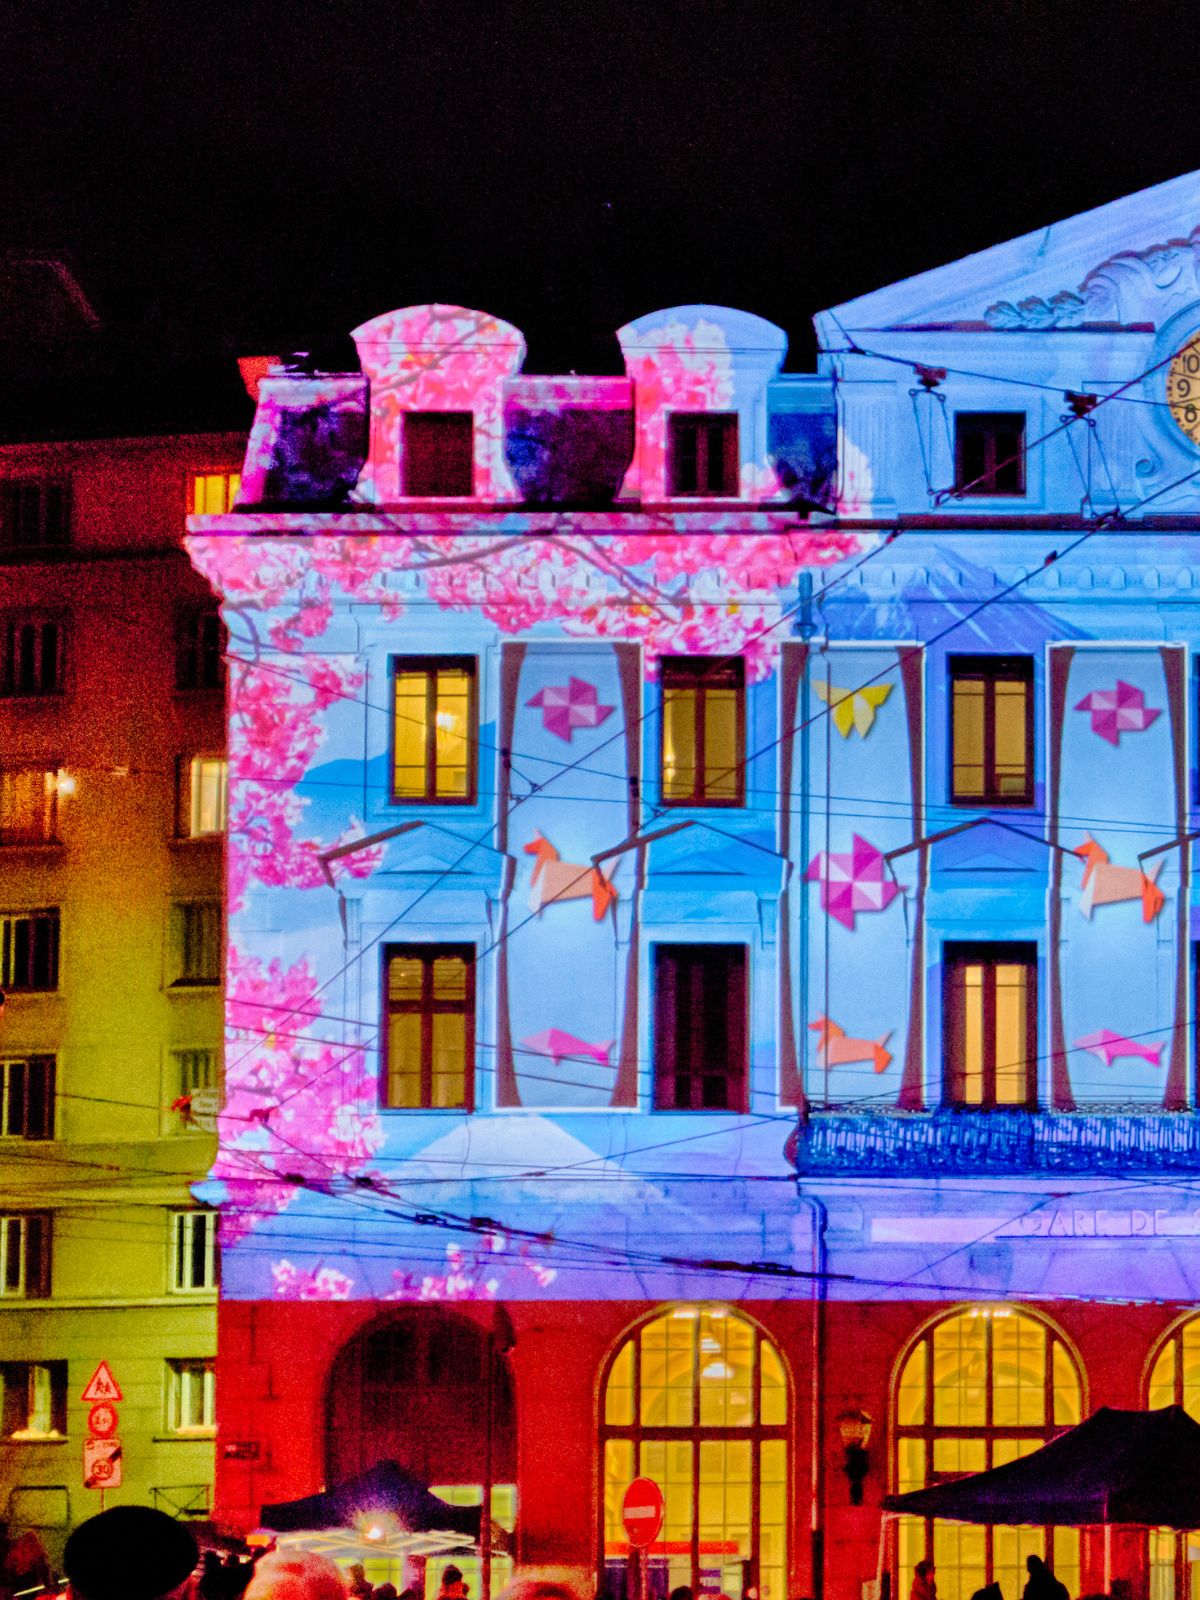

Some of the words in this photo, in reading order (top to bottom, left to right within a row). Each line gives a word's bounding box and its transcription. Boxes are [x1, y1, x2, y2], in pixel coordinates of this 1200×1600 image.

[1182, 353, 1200, 374] 10
[1177, 378, 1191, 398] 9
[1184, 403, 1198, 423] 8
[1020, 1209, 1108, 1237] GARE
[1130, 1209, 1168, 1237] DE
